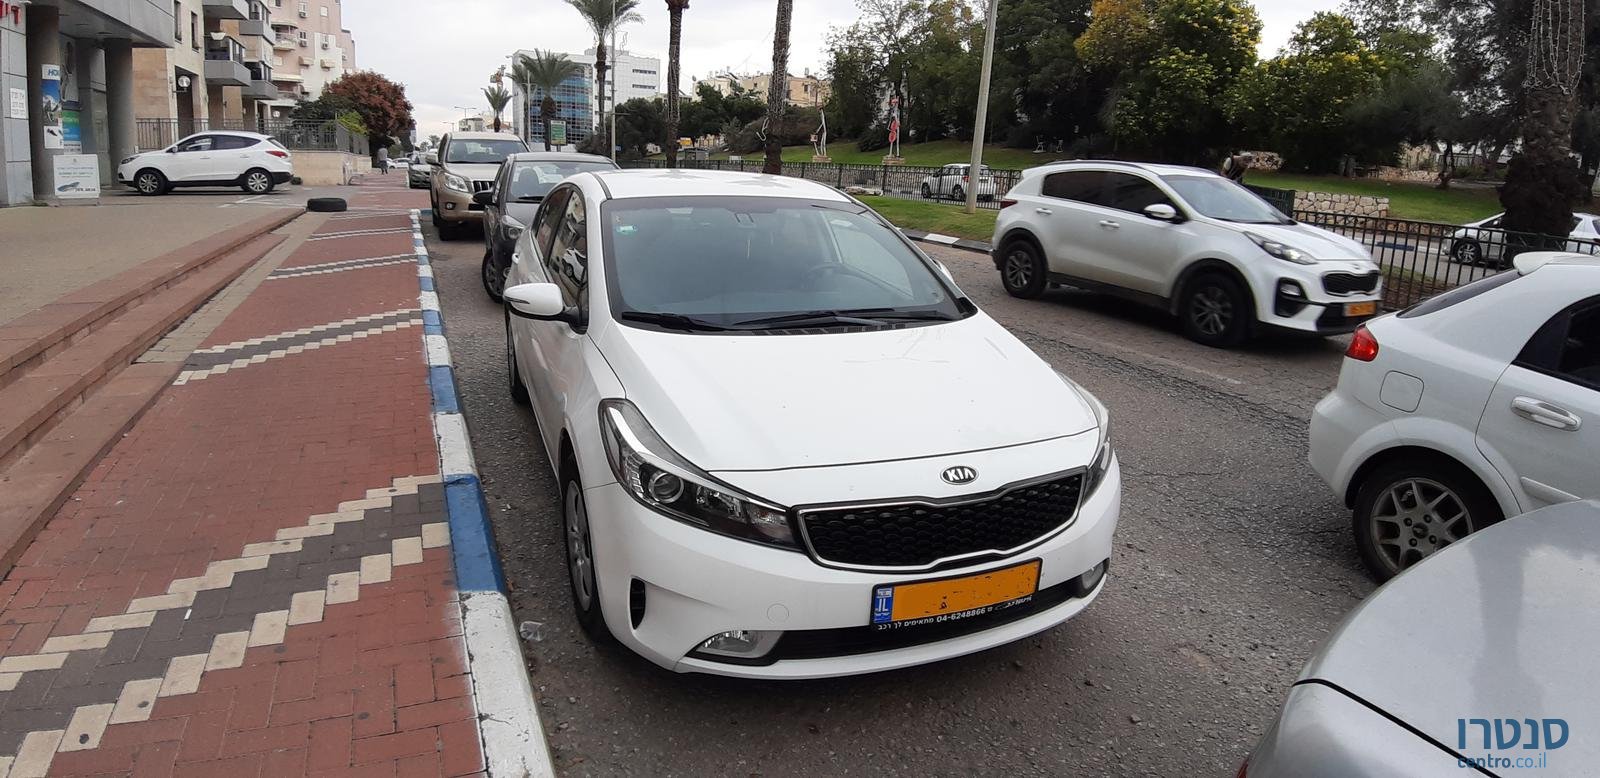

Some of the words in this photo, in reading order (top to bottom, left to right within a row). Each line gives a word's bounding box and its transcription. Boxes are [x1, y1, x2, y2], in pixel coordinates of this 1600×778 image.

[945, 467, 975, 481] KIA
[878, 598, 889, 612] IL
[936, 607, 986, 623] 04-6248866
